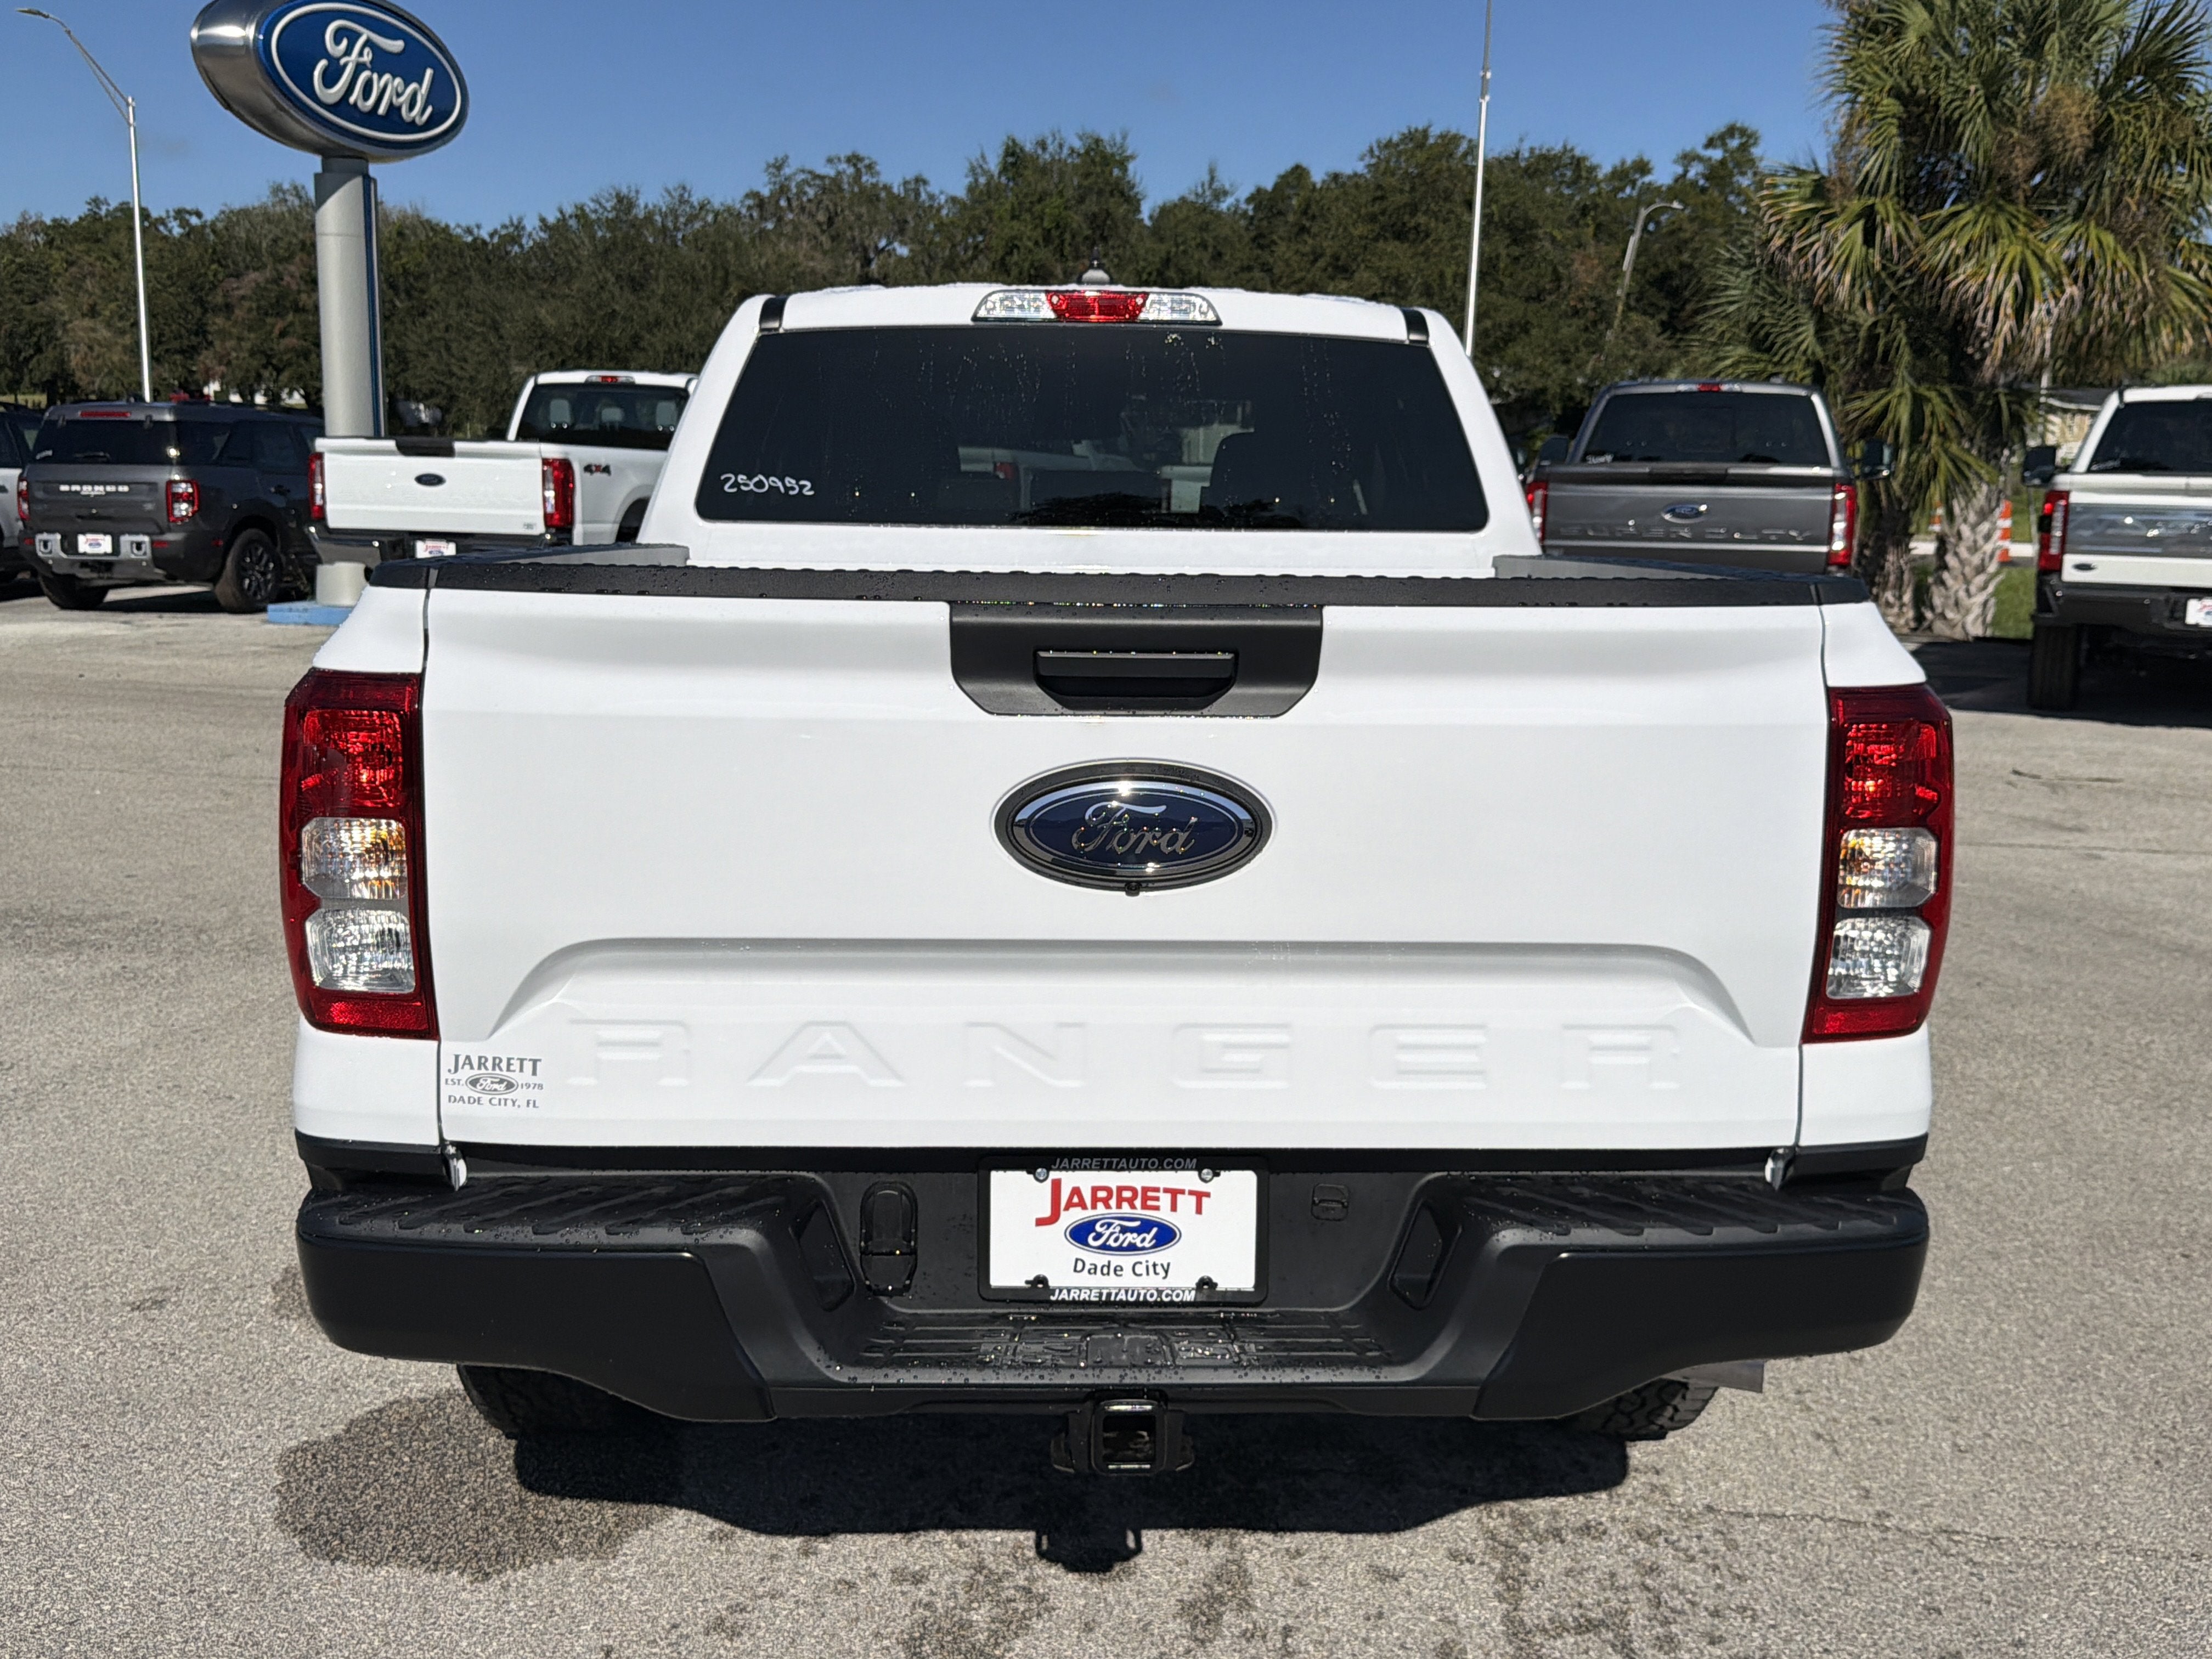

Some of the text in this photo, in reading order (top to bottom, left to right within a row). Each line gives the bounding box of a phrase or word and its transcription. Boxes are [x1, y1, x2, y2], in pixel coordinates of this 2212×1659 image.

[313, 19, 434, 126] Ford
[720, 473, 815, 495] 250952
[1071, 802, 1198, 854] Ford
[447, 1054, 542, 1076] JARRETT
[564, 1019, 1680, 1090] RANGER
[445, 1077, 544, 1091] EST. Ford 1978
[448, 1094, 539, 1108] DADE CITY, FL
[1051, 1158, 1197, 1170] JARRETTAUTO.COM
[1035, 1178, 1211, 1227] JARRETT
[1088, 1219, 1158, 1248] Ford
[1073, 1258, 1171, 1279] Dade City
[1050, 1288, 1196, 1302] JARRETTAUTO.COM
